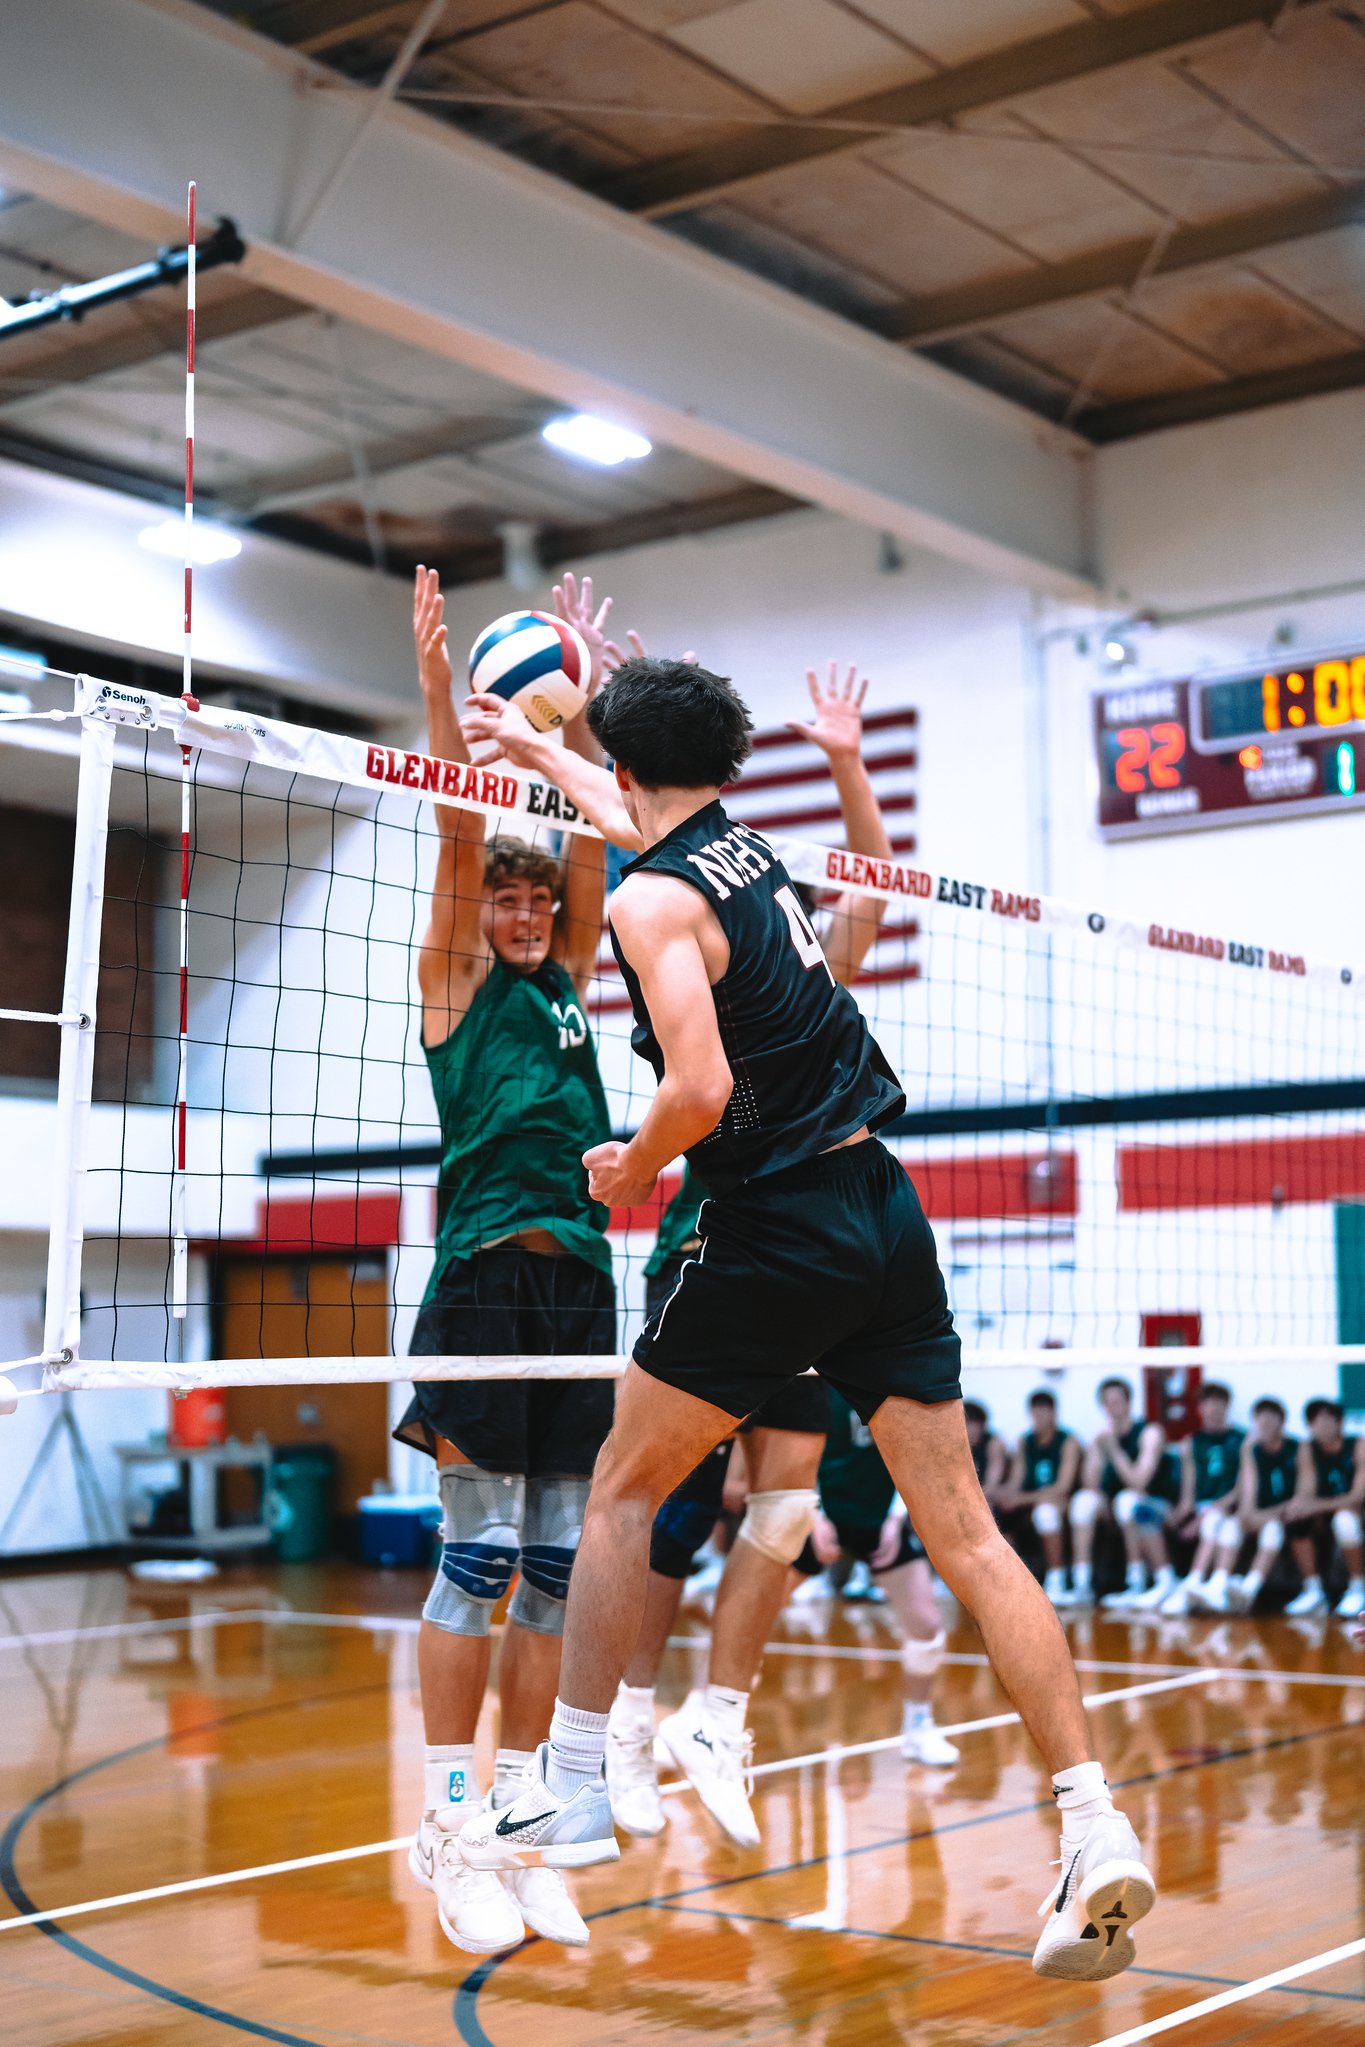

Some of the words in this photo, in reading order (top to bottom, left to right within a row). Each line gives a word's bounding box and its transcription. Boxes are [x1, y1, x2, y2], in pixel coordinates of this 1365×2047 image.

[112, 690, 146, 705] Senoh
[366, 745, 519, 809] GLENBARD
[527, 782, 591, 825] EAS
[1116, 722, 1185, 792] 22
[826, 851, 931, 898] GLENBARD
[937, 876, 985, 909] EAST
[991, 888, 1041, 922] RAMS
[774, 885, 836, 988] 4
[1228, 942, 1264, 968] EAST
